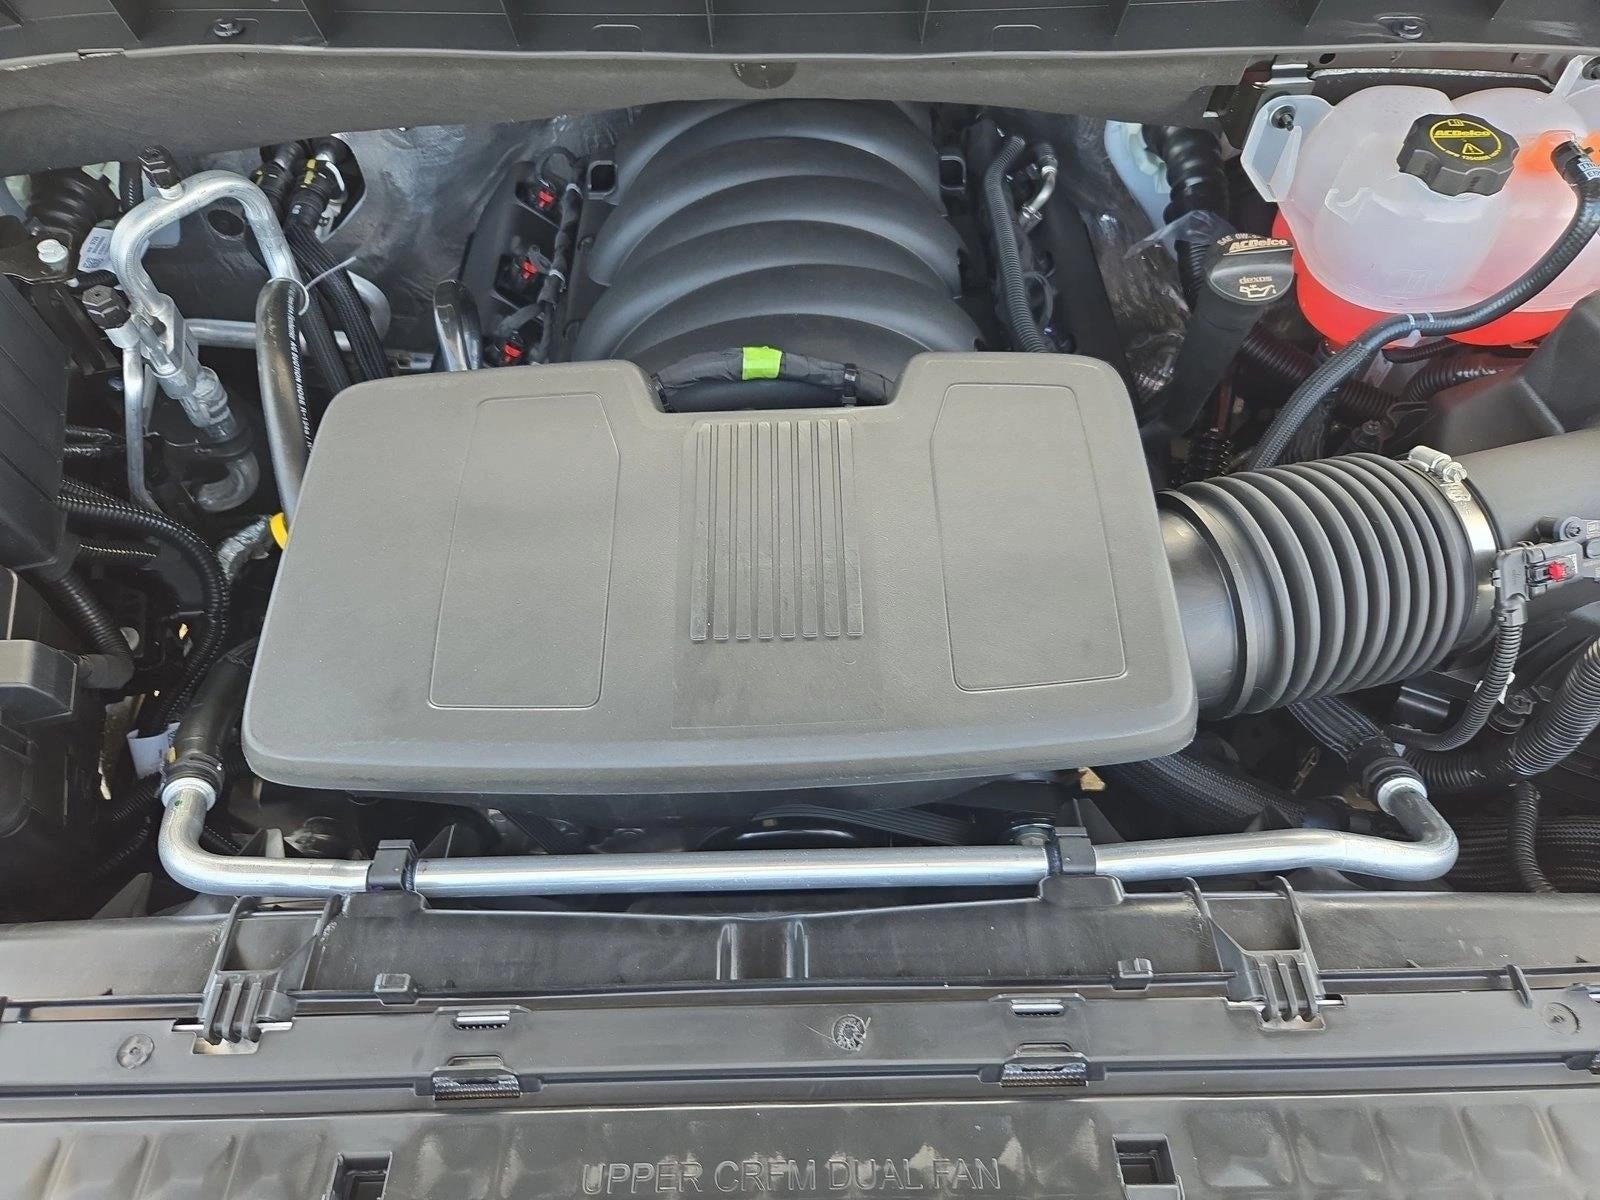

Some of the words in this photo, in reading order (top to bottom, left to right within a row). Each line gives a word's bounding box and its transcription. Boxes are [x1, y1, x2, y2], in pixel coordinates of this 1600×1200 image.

[1433, 129, 1491, 139] ACDelco
[1216, 235, 1234, 246] SAE
[1229, 238, 1288, 253] ACDelco
[296, 382, 306, 406] HOSE
[582, 1160, 704, 1195] UPPER
[714, 1159, 816, 1192] CRFM
[828, 1158, 924, 1190] DUAL
[932, 1158, 1001, 1190] FAN
